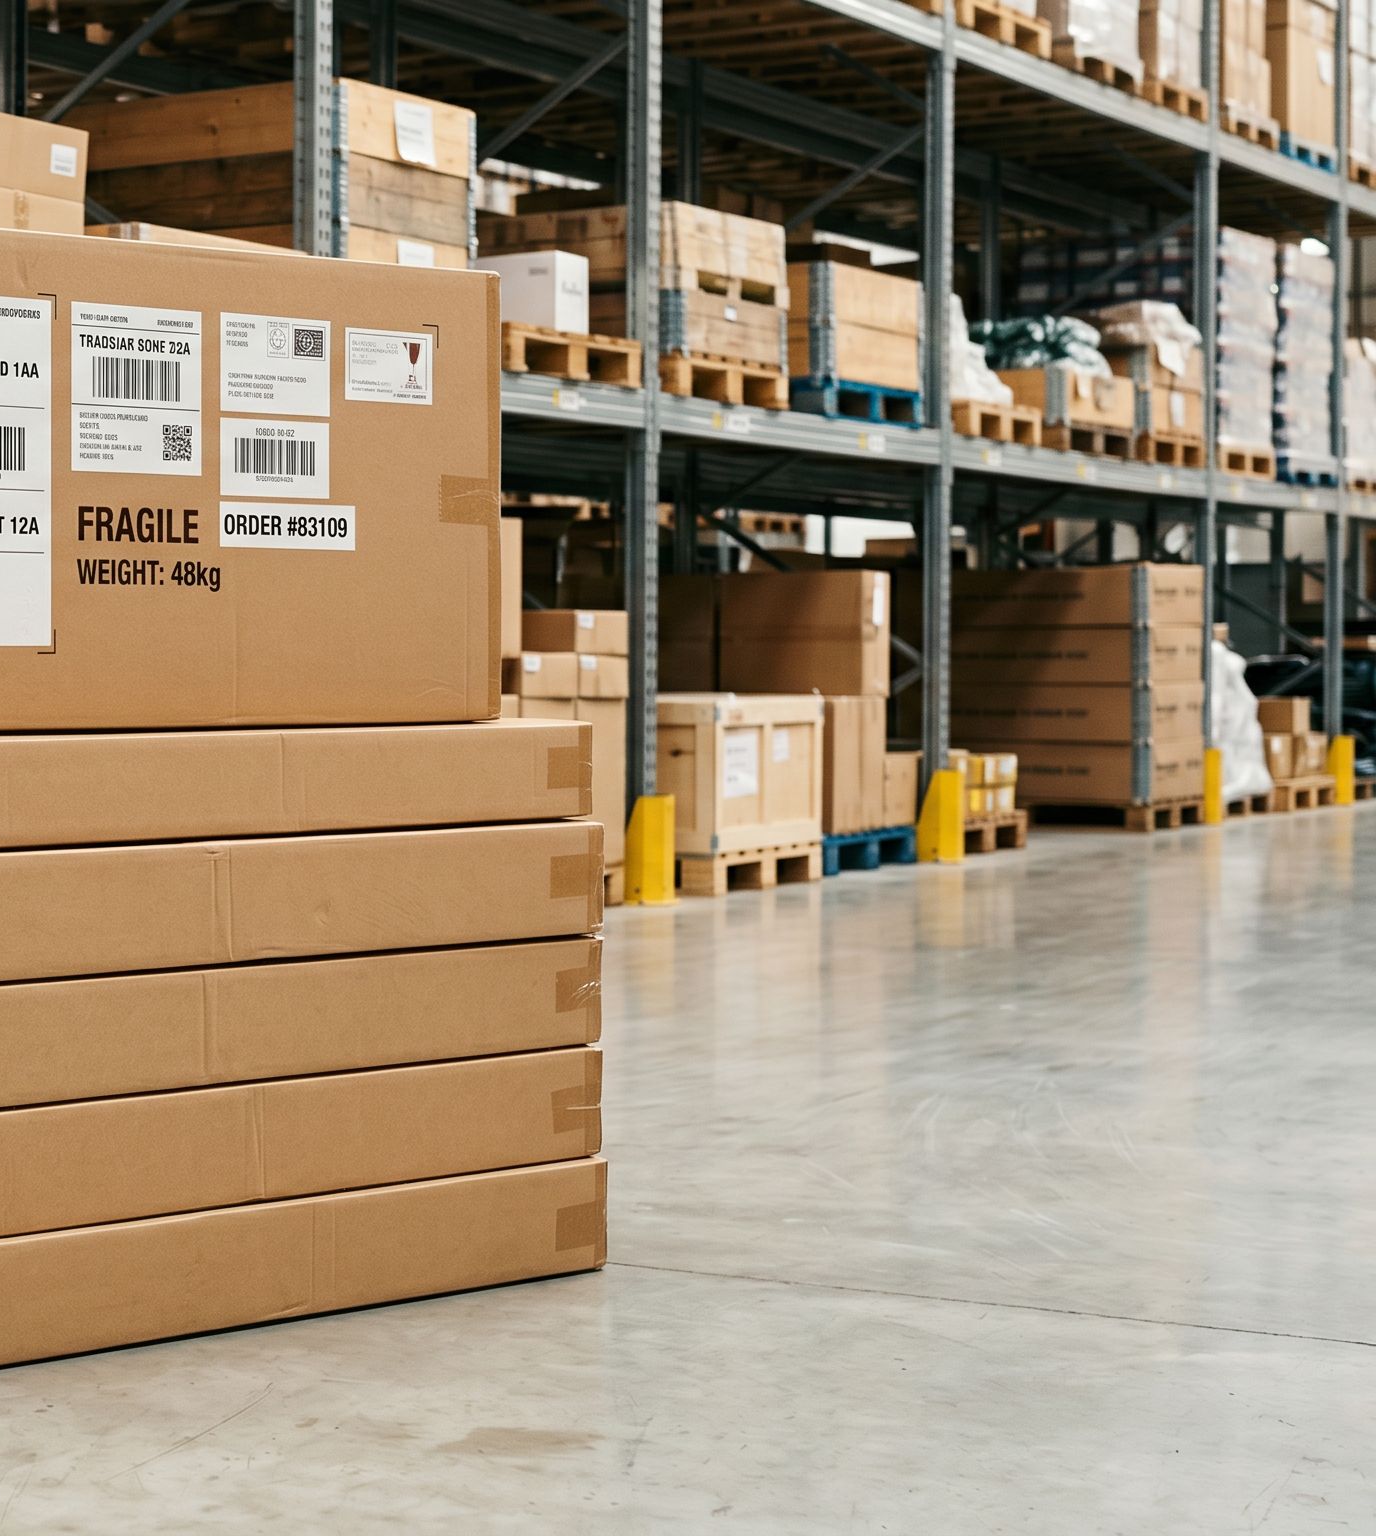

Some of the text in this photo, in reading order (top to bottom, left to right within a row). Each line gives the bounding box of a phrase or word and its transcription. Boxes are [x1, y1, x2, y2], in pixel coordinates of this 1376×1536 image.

[137, 338, 166, 353] SONE
[13, 361, 39, 379] 1AA
[10, 516, 40, 535] 12A
[77, 505, 199, 544] FRAGILE
[224, 513, 348, 538] ORDER #83109
[77, 558, 221, 592] WEIGHT: 48kg
